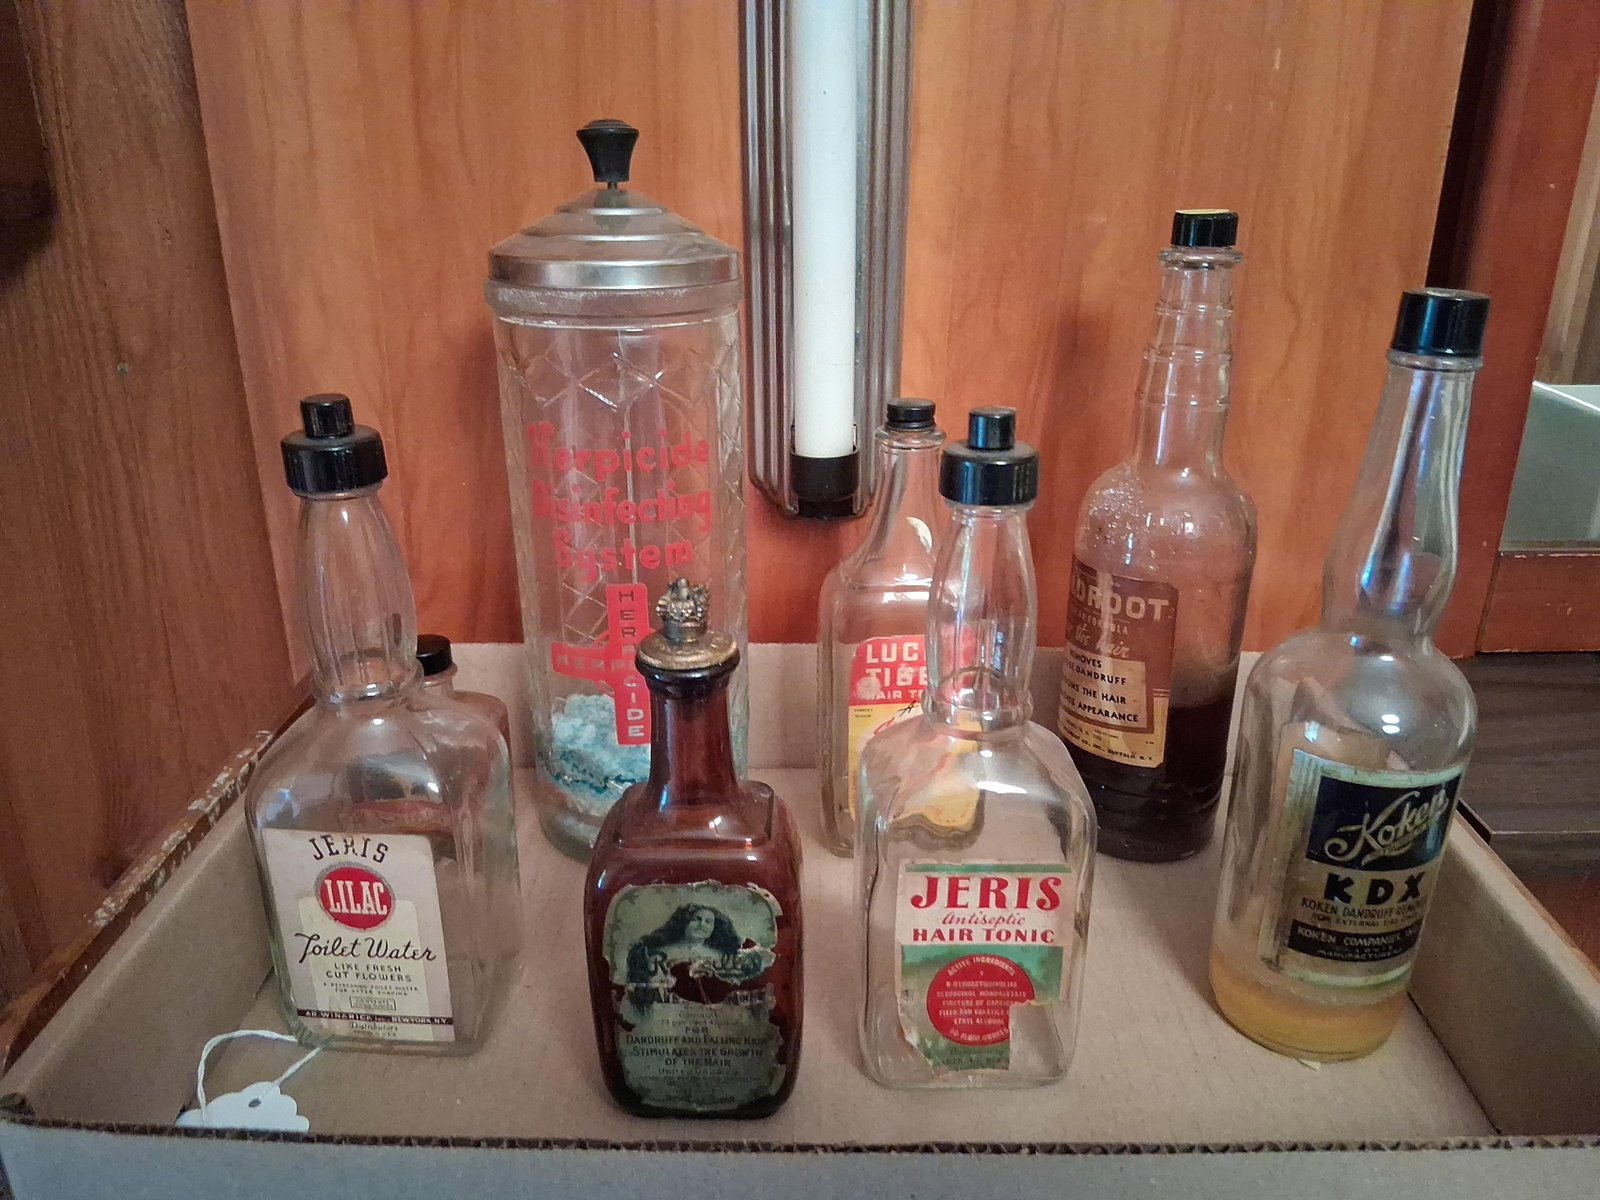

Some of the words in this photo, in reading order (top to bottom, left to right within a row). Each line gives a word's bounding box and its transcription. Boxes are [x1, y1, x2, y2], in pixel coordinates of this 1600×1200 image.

[527, 420, 710, 482] Herpicide
[532, 479, 712, 534] Disinfecting
[552, 529, 694, 583] System
[866, 642, 926, 664] LUC
[865, 667, 928, 688] TIGE
[1076, 665, 1127, 686] DANDRUFF
[1082, 687, 1098, 699] THE
[1101, 692, 1127, 705] HAIR
[1077, 701, 1139, 723] APPEARANCE
[1324, 788, 1450, 866] Koken
[308, 834, 389, 864] JERIS
[324, 878, 388, 916] LILAC
[910, 875, 1063, 912] JERIS
[1302, 896, 1339, 916] KOKEN
[1342, 907, 1394, 920] DANDRUFF
[942, 911, 1027, 928] Antiseptic
[912, 928, 974, 942] HAIR
[982, 928, 1055, 944] TONIC
[1297, 926, 1337, 944] KOKEN
[294, 932, 362, 964] Toilet
[364, 936, 437, 962] Water
[325, 971, 349, 980] CUT
[355, 971, 413, 983] FLOWERS
[334, 962, 359, 972] LIKE
[365, 963, 402, 973] FRESH
